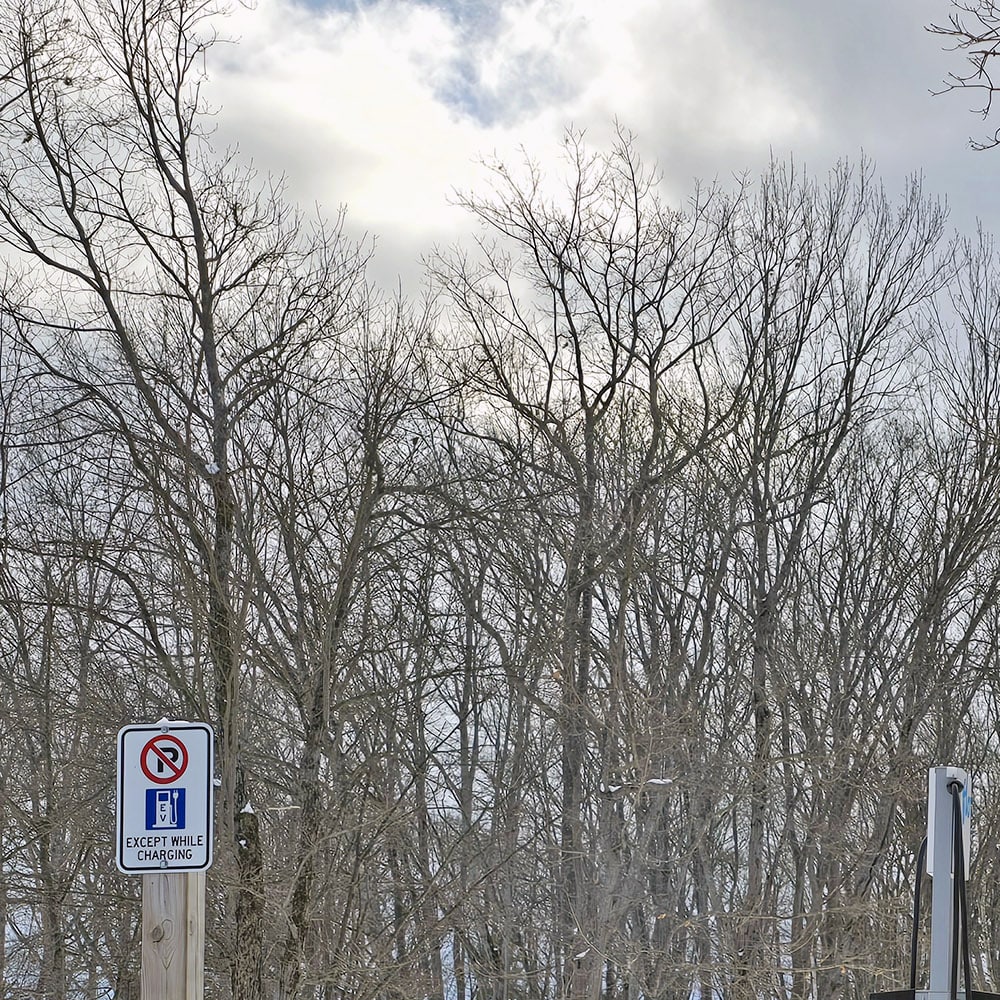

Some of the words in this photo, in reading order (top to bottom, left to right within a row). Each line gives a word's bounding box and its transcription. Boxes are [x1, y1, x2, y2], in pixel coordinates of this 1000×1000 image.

[127, 836, 168, 848] EXCEPT
[171, 835, 204, 847] WHILE
[137, 848, 193, 861] CHARGING
